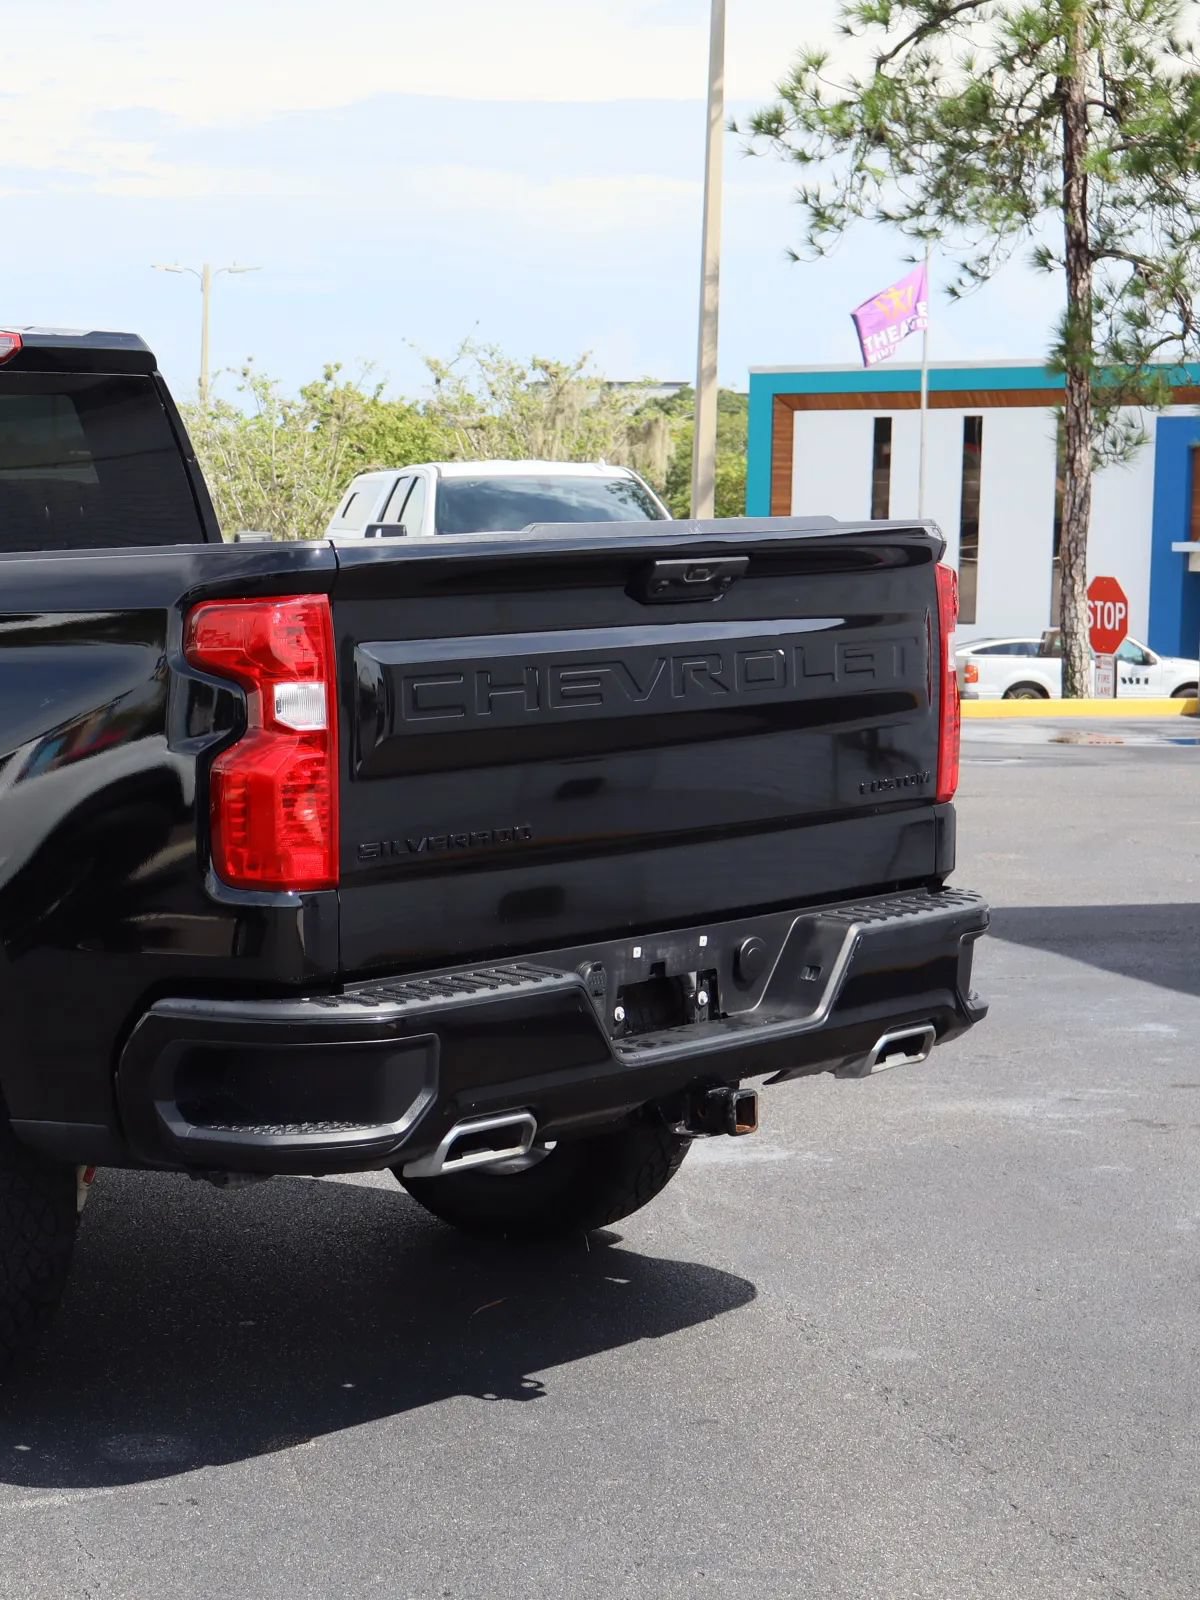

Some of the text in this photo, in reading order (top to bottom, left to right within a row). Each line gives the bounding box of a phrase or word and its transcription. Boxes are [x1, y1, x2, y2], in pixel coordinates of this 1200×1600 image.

[1087, 600, 1126, 631] STOP
[402, 637, 919, 722] CHEVROLET
[357, 824, 533, 861] SILVERADO
